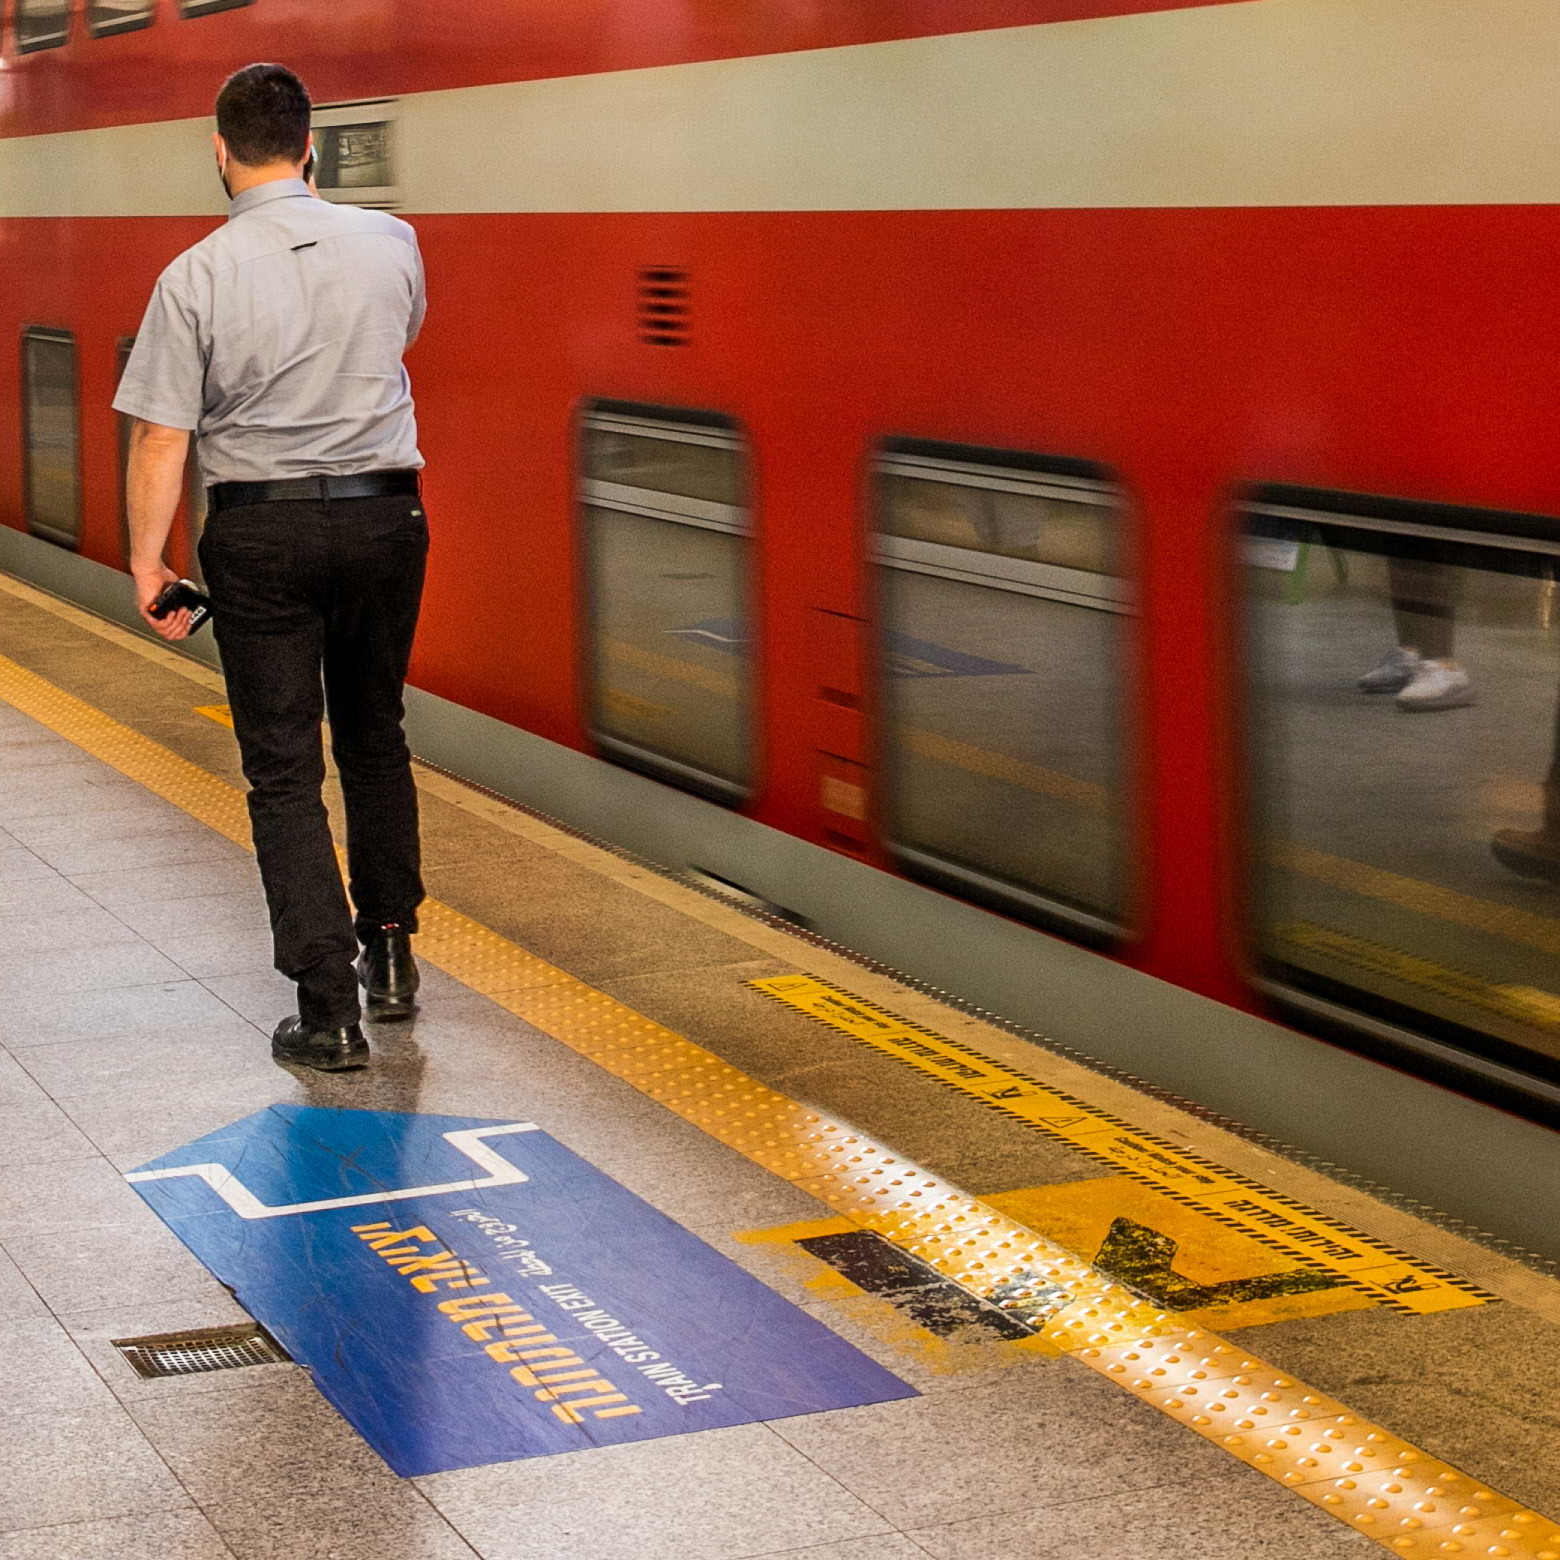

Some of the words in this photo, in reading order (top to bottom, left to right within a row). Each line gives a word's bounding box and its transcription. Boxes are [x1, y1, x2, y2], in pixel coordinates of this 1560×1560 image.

[534, 1280, 598, 1310] EXIT
[345, 1216, 493, 1294] יציאה
[429, 1291, 646, 1425] מהתחנה
[569, 1308, 663, 1363] STATION
[633, 1360, 717, 1405] TRAIN
